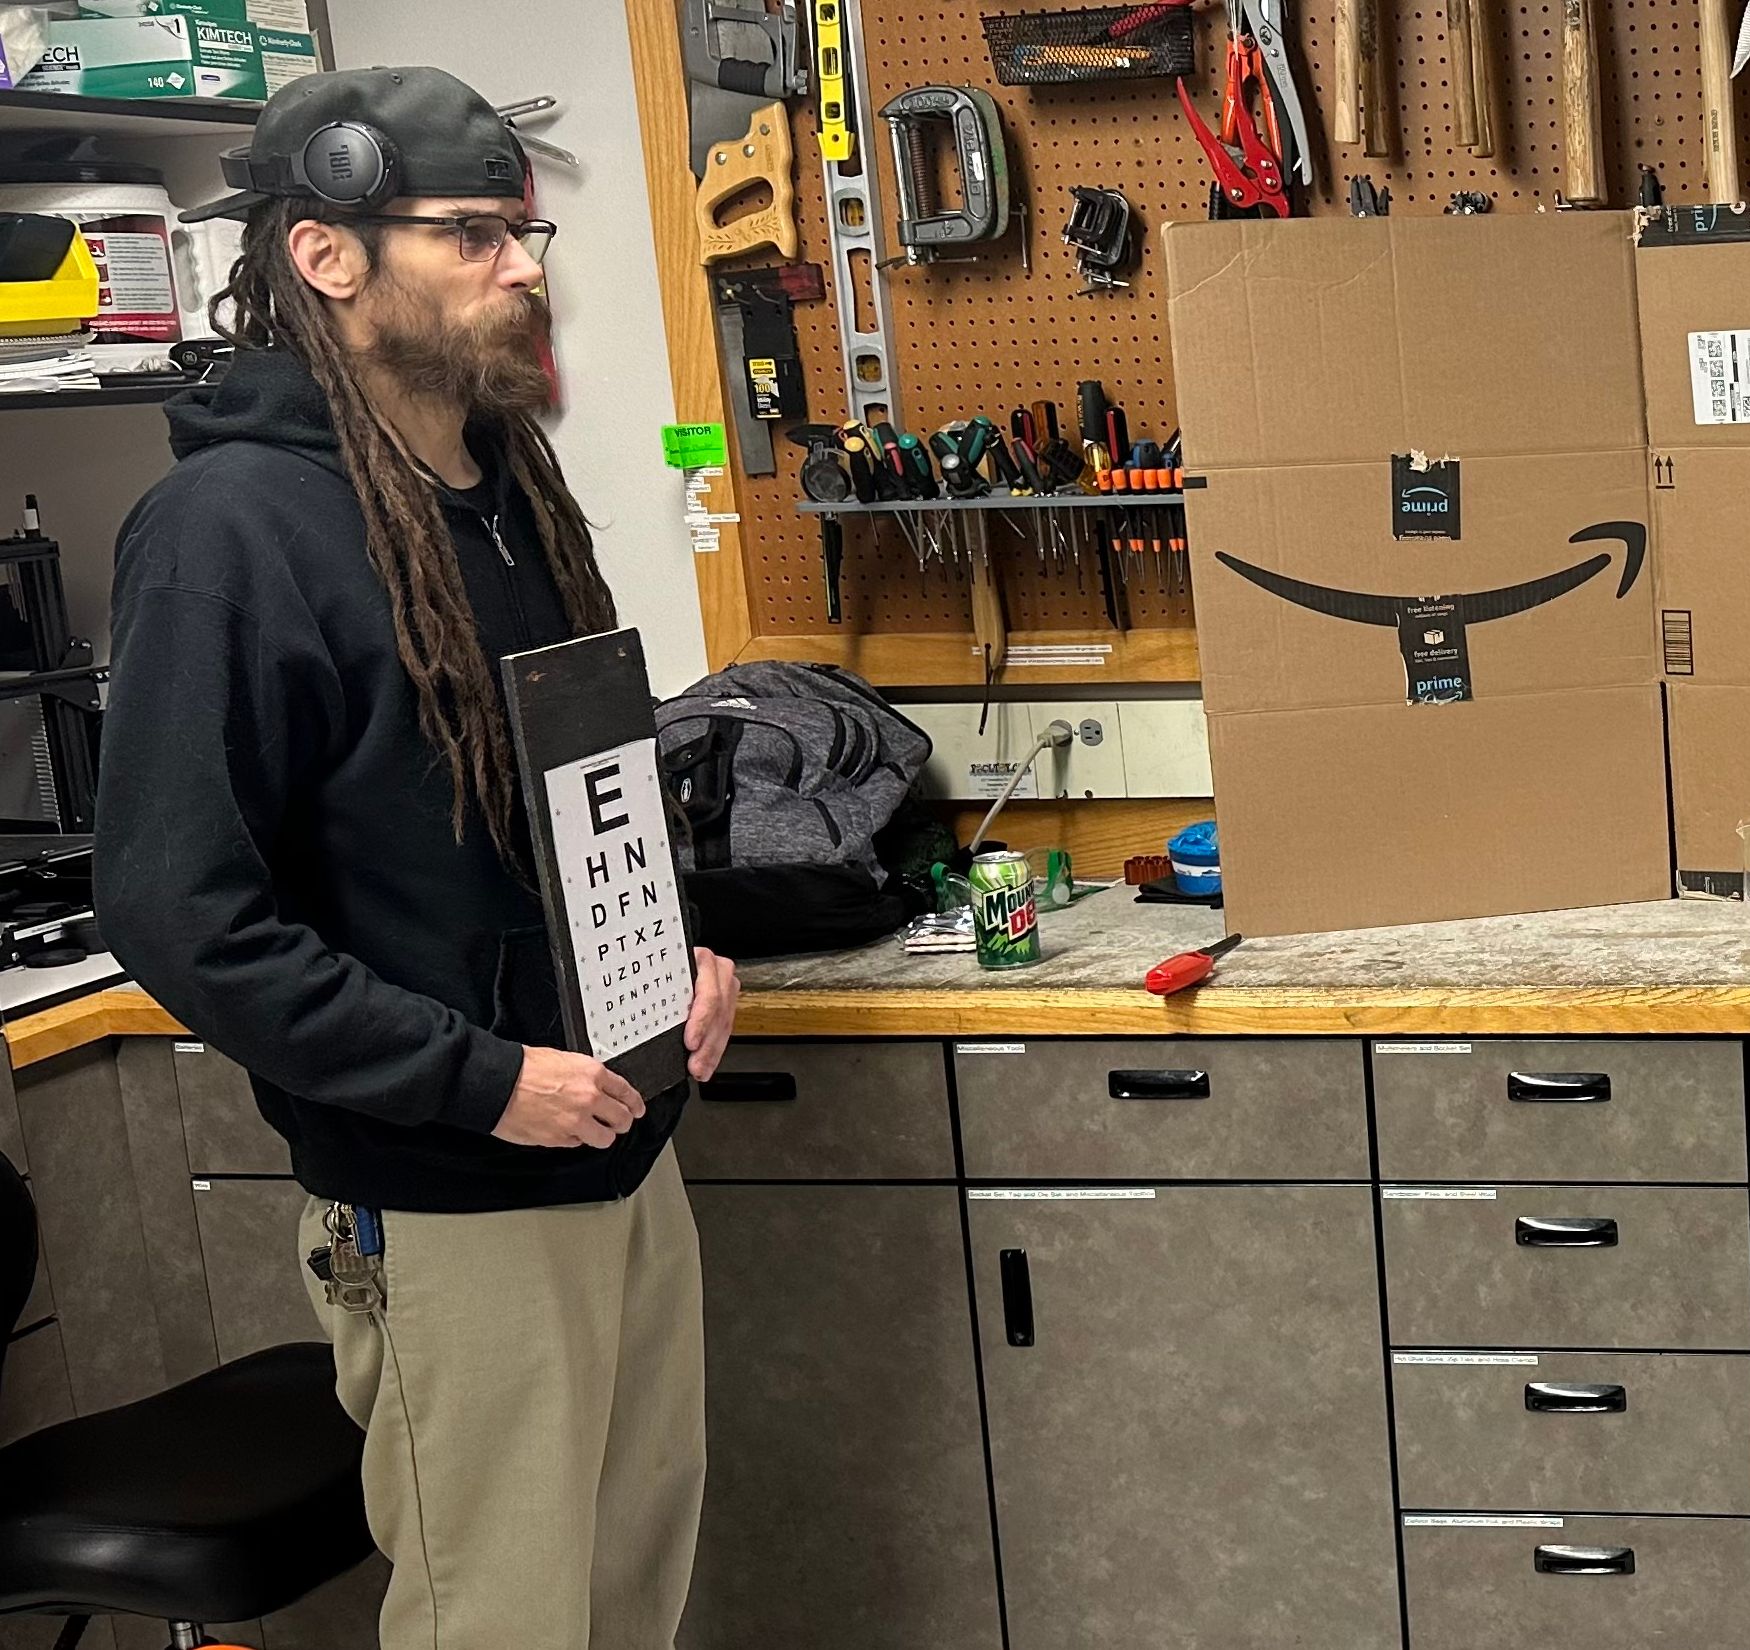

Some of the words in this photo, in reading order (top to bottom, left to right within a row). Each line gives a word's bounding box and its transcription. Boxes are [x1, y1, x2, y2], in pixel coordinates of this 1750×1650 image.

[196, 26, 252, 45] KIMTECH
[148, 77, 165, 89] 140
[329, 144, 353, 180] JBL
[674, 426, 712, 438] VISITOR
[1401, 498, 1449, 517] prime
[1414, 651, 1428, 659] free
[1430, 648, 1457, 657] delivery
[1416, 675, 1462, 695] prime
[584, 763, 630, 836] E
[586, 851, 610, 889] H
[623, 836, 647, 874] N
